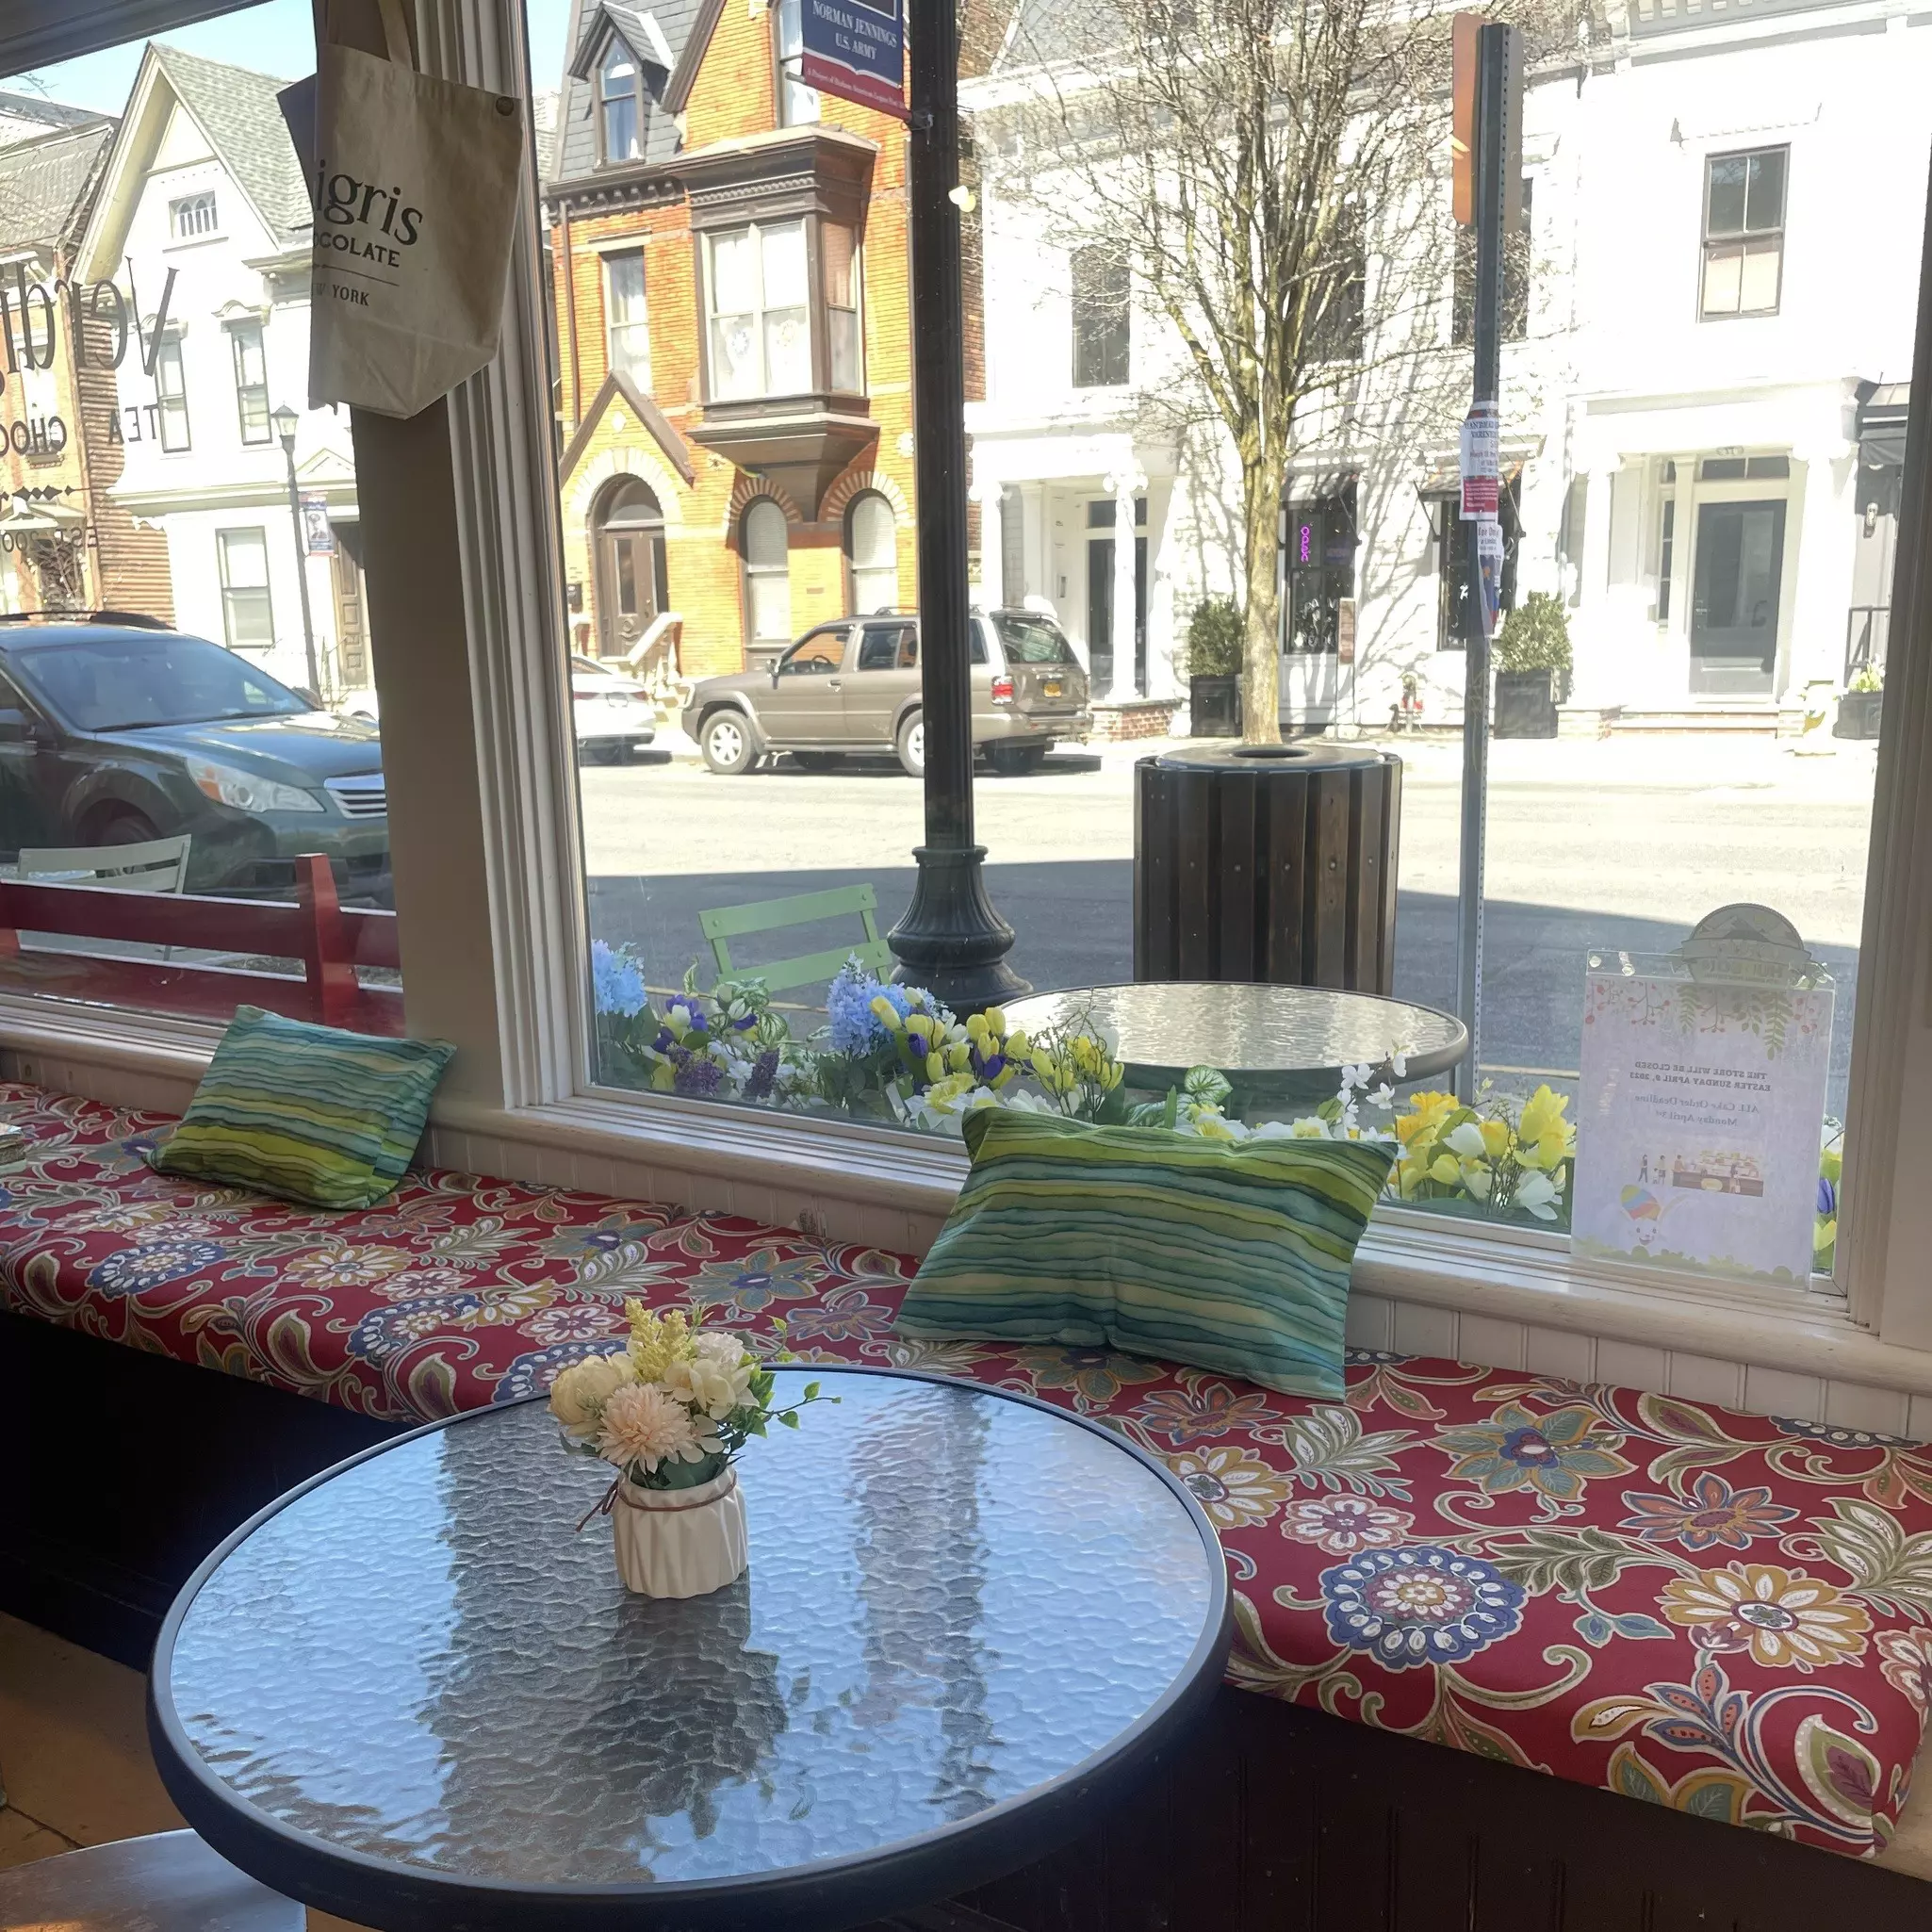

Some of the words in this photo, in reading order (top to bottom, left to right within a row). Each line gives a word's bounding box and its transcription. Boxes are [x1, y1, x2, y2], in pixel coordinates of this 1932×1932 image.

[812, 0, 853, 29] NORMAN
[854, 18, 897, 48] JENNINGS
[835, 32, 851, 51] U.S.
[851, 40, 876, 59] ARMY
[332, 284, 369, 306] YORK
